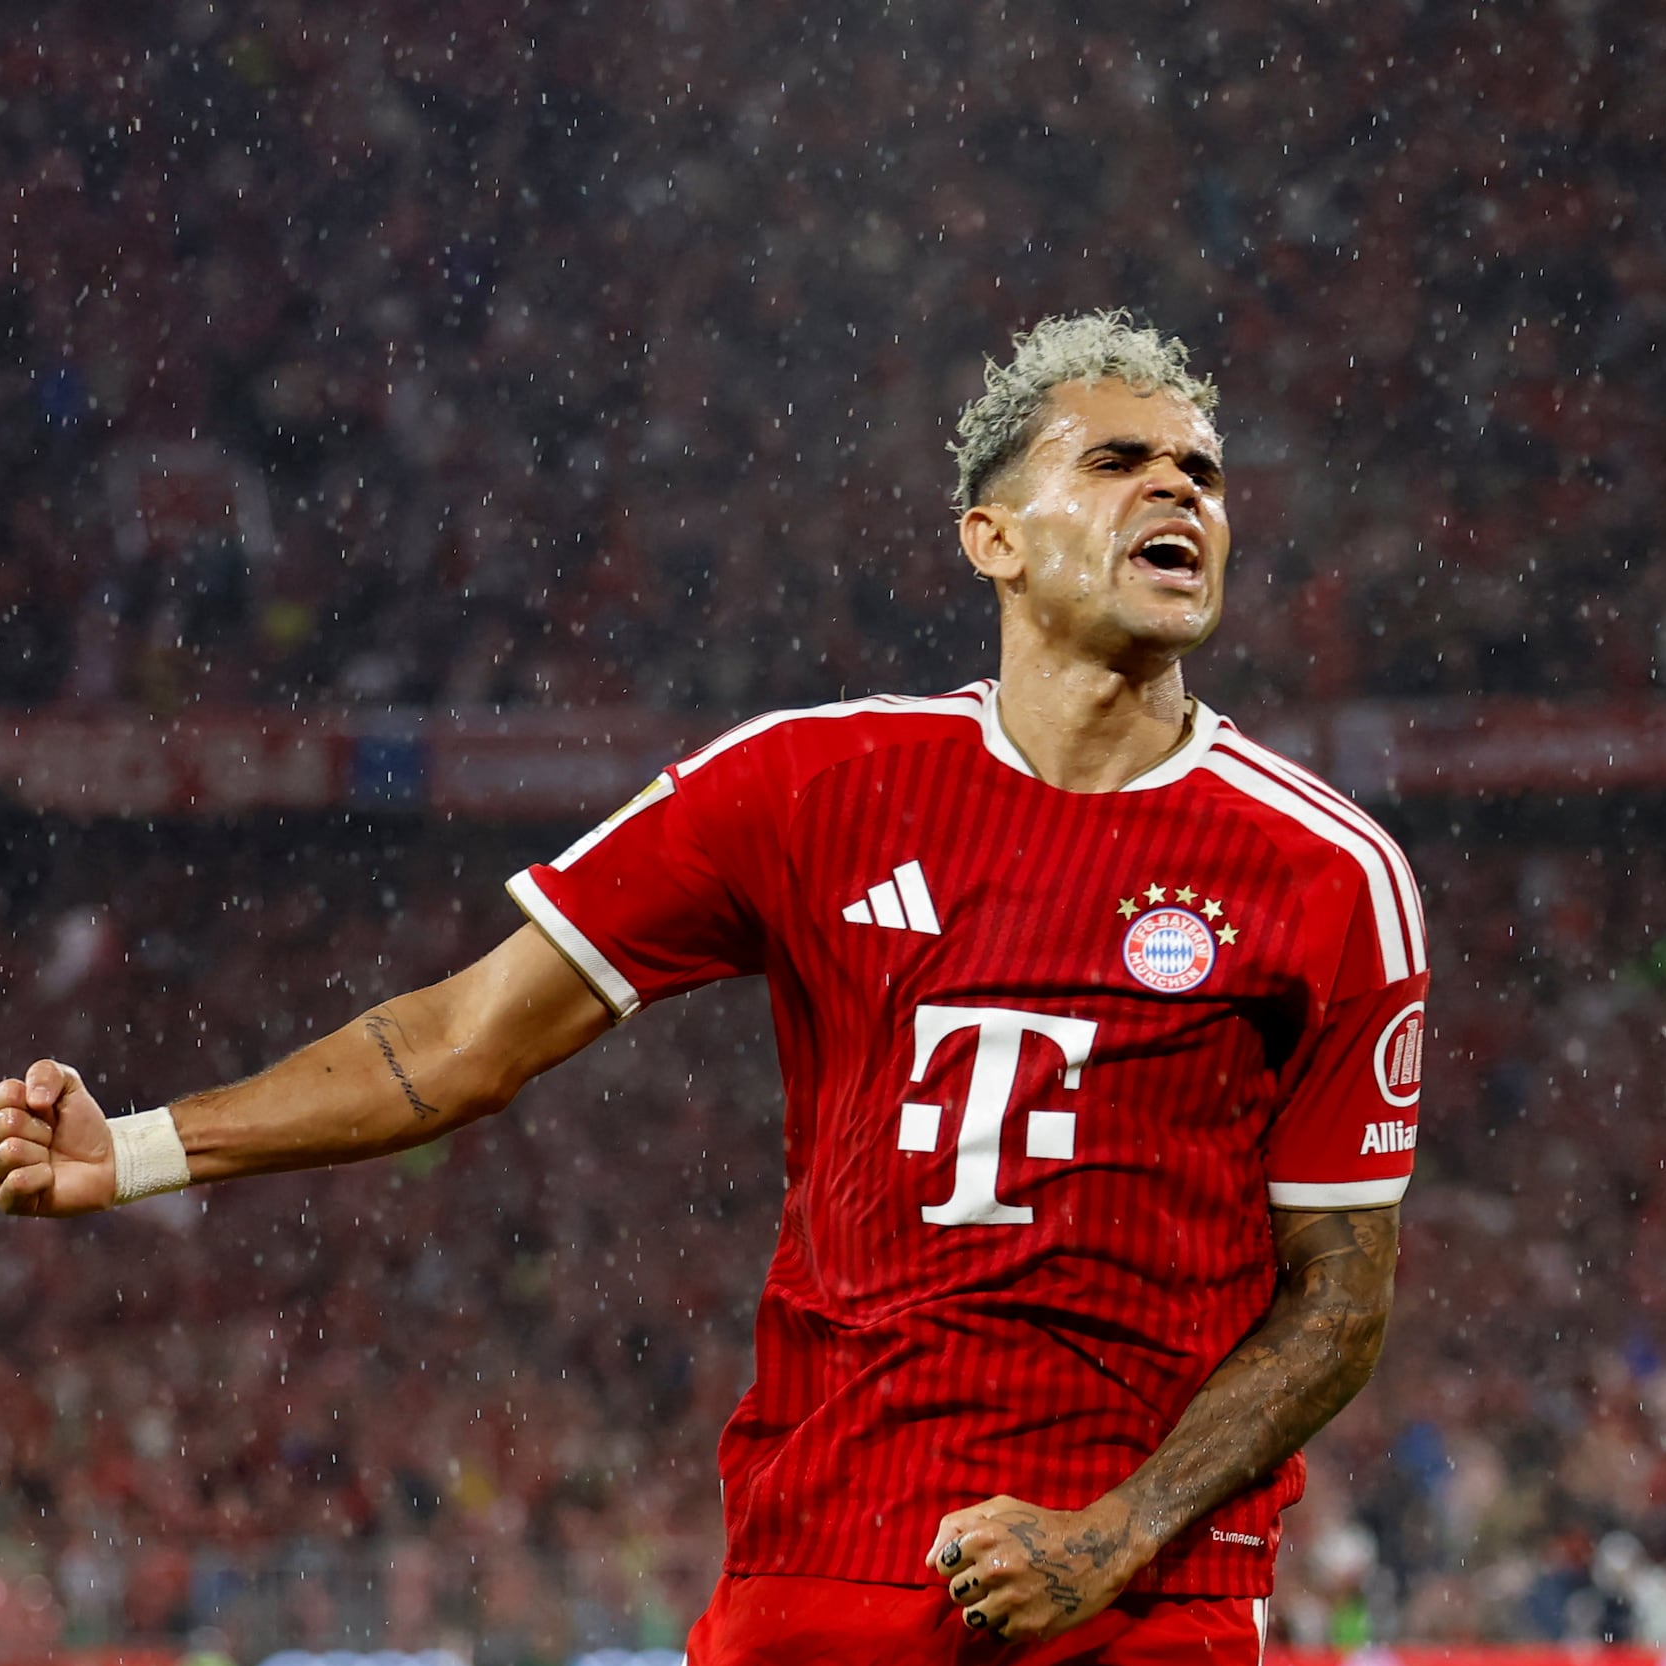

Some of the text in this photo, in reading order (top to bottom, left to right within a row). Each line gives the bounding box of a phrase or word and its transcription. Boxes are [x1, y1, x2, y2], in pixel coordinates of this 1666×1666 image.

[1135, 914, 1210, 958] FC BAYERN
[903, 1004, 1099, 1226] T
